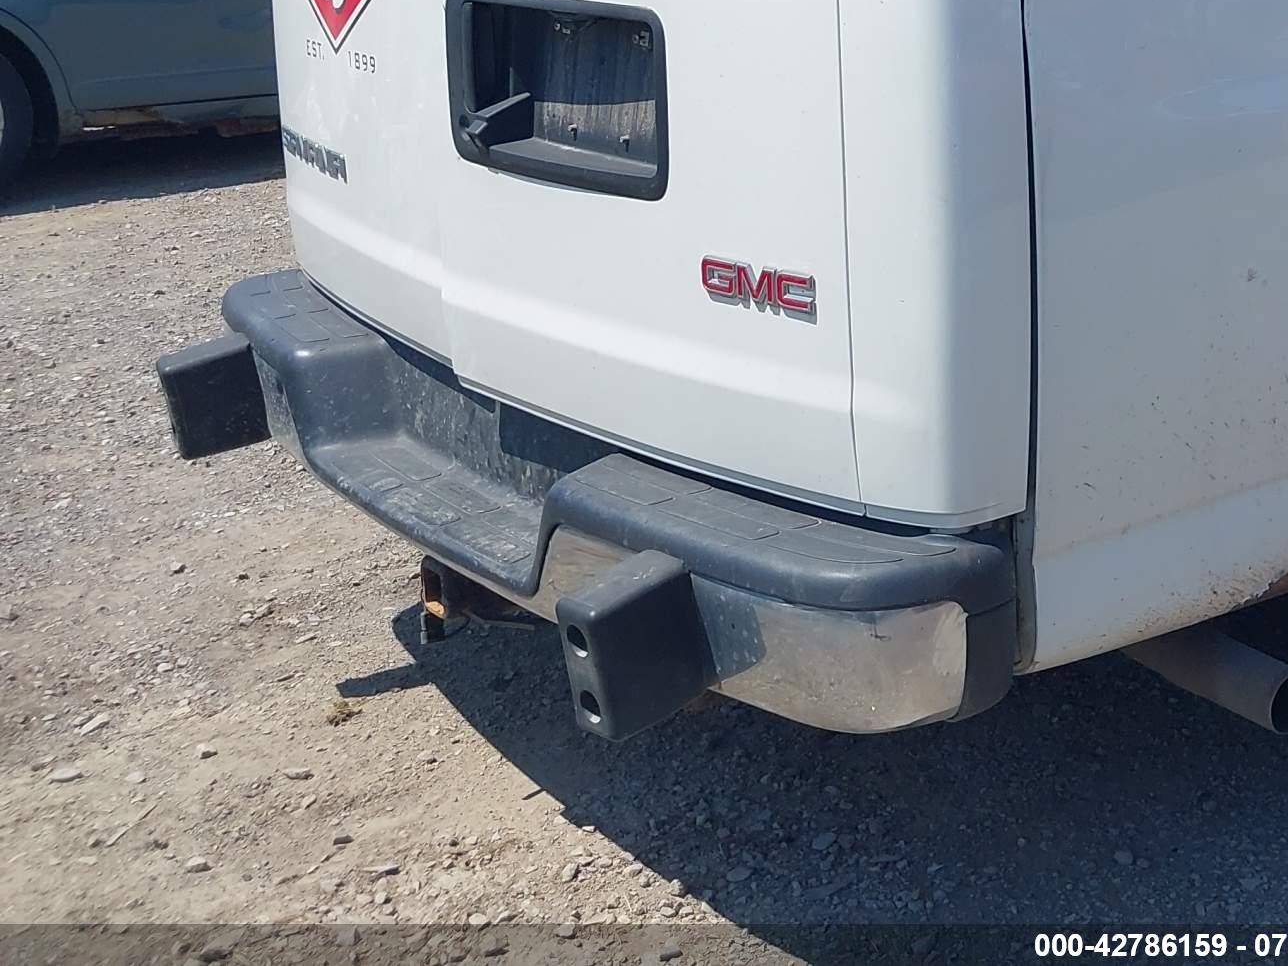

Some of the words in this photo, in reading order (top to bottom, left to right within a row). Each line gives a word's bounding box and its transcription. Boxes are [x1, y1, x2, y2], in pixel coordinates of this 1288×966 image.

[306, 39, 325, 60] EST.
[348, 51, 376, 73] 1899
[700, 254, 818, 324] GMC
